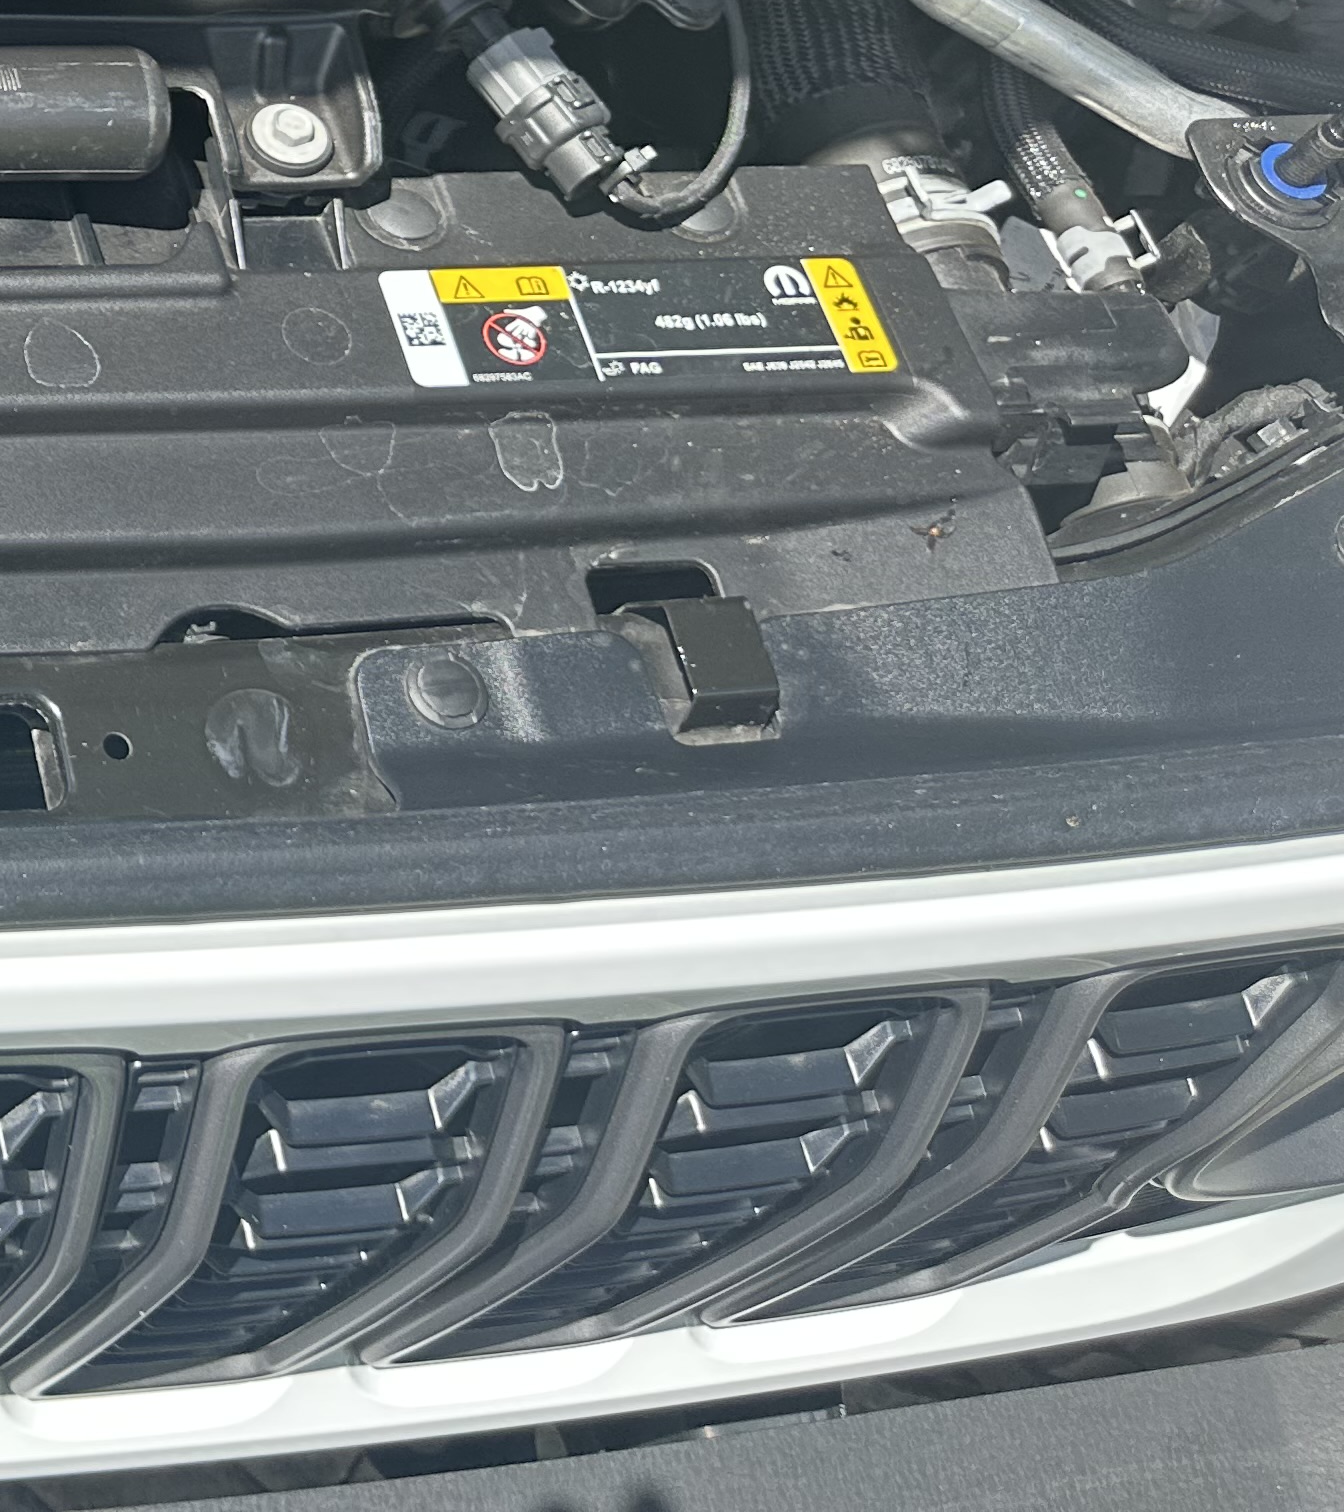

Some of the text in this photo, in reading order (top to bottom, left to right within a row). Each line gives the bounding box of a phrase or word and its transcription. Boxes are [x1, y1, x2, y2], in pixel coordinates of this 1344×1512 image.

[590, 278, 660, 296] R-1234yf
[733, 311, 768, 329] lbs)
[630, 361, 664, 376] PAG
